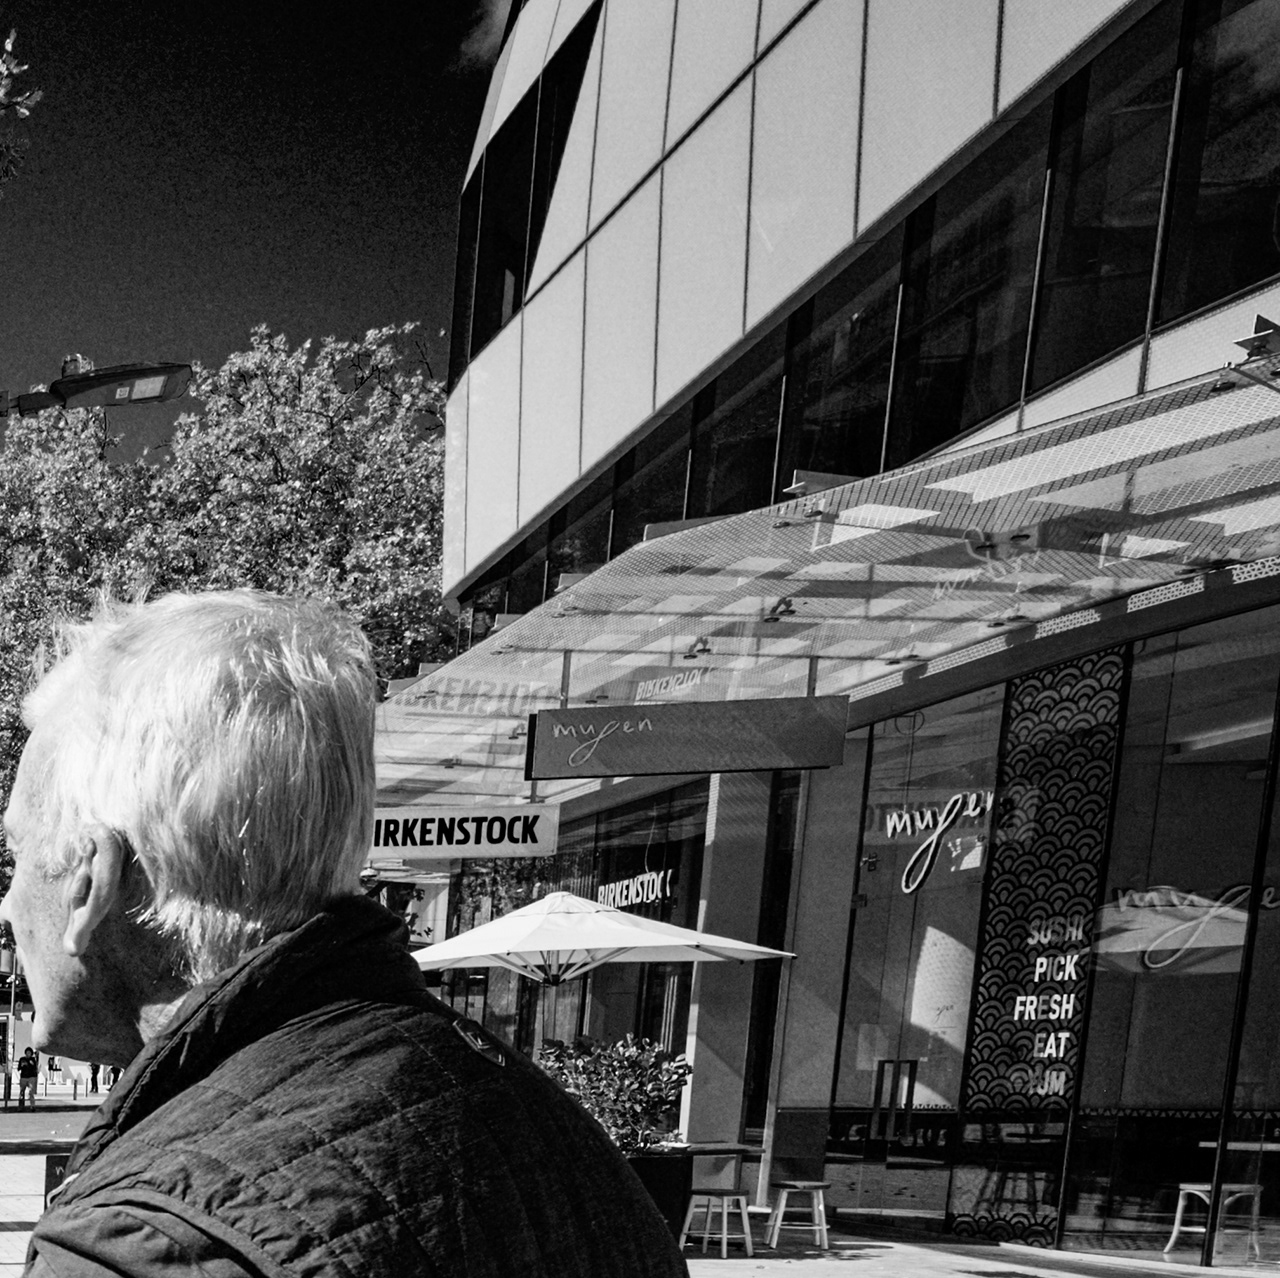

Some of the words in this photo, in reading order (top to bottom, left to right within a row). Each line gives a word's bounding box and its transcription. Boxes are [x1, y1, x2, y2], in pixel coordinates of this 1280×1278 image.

[372, 814, 540, 848] IRKENSTOCK
[1027, 915, 1085, 946] SUSHI
[1117, 884, 1280, 968] muge
[1034, 954, 1080, 983] PICK
[1013, 993, 1076, 1021] FRESH
[1033, 1031, 1071, 1058] EAT
